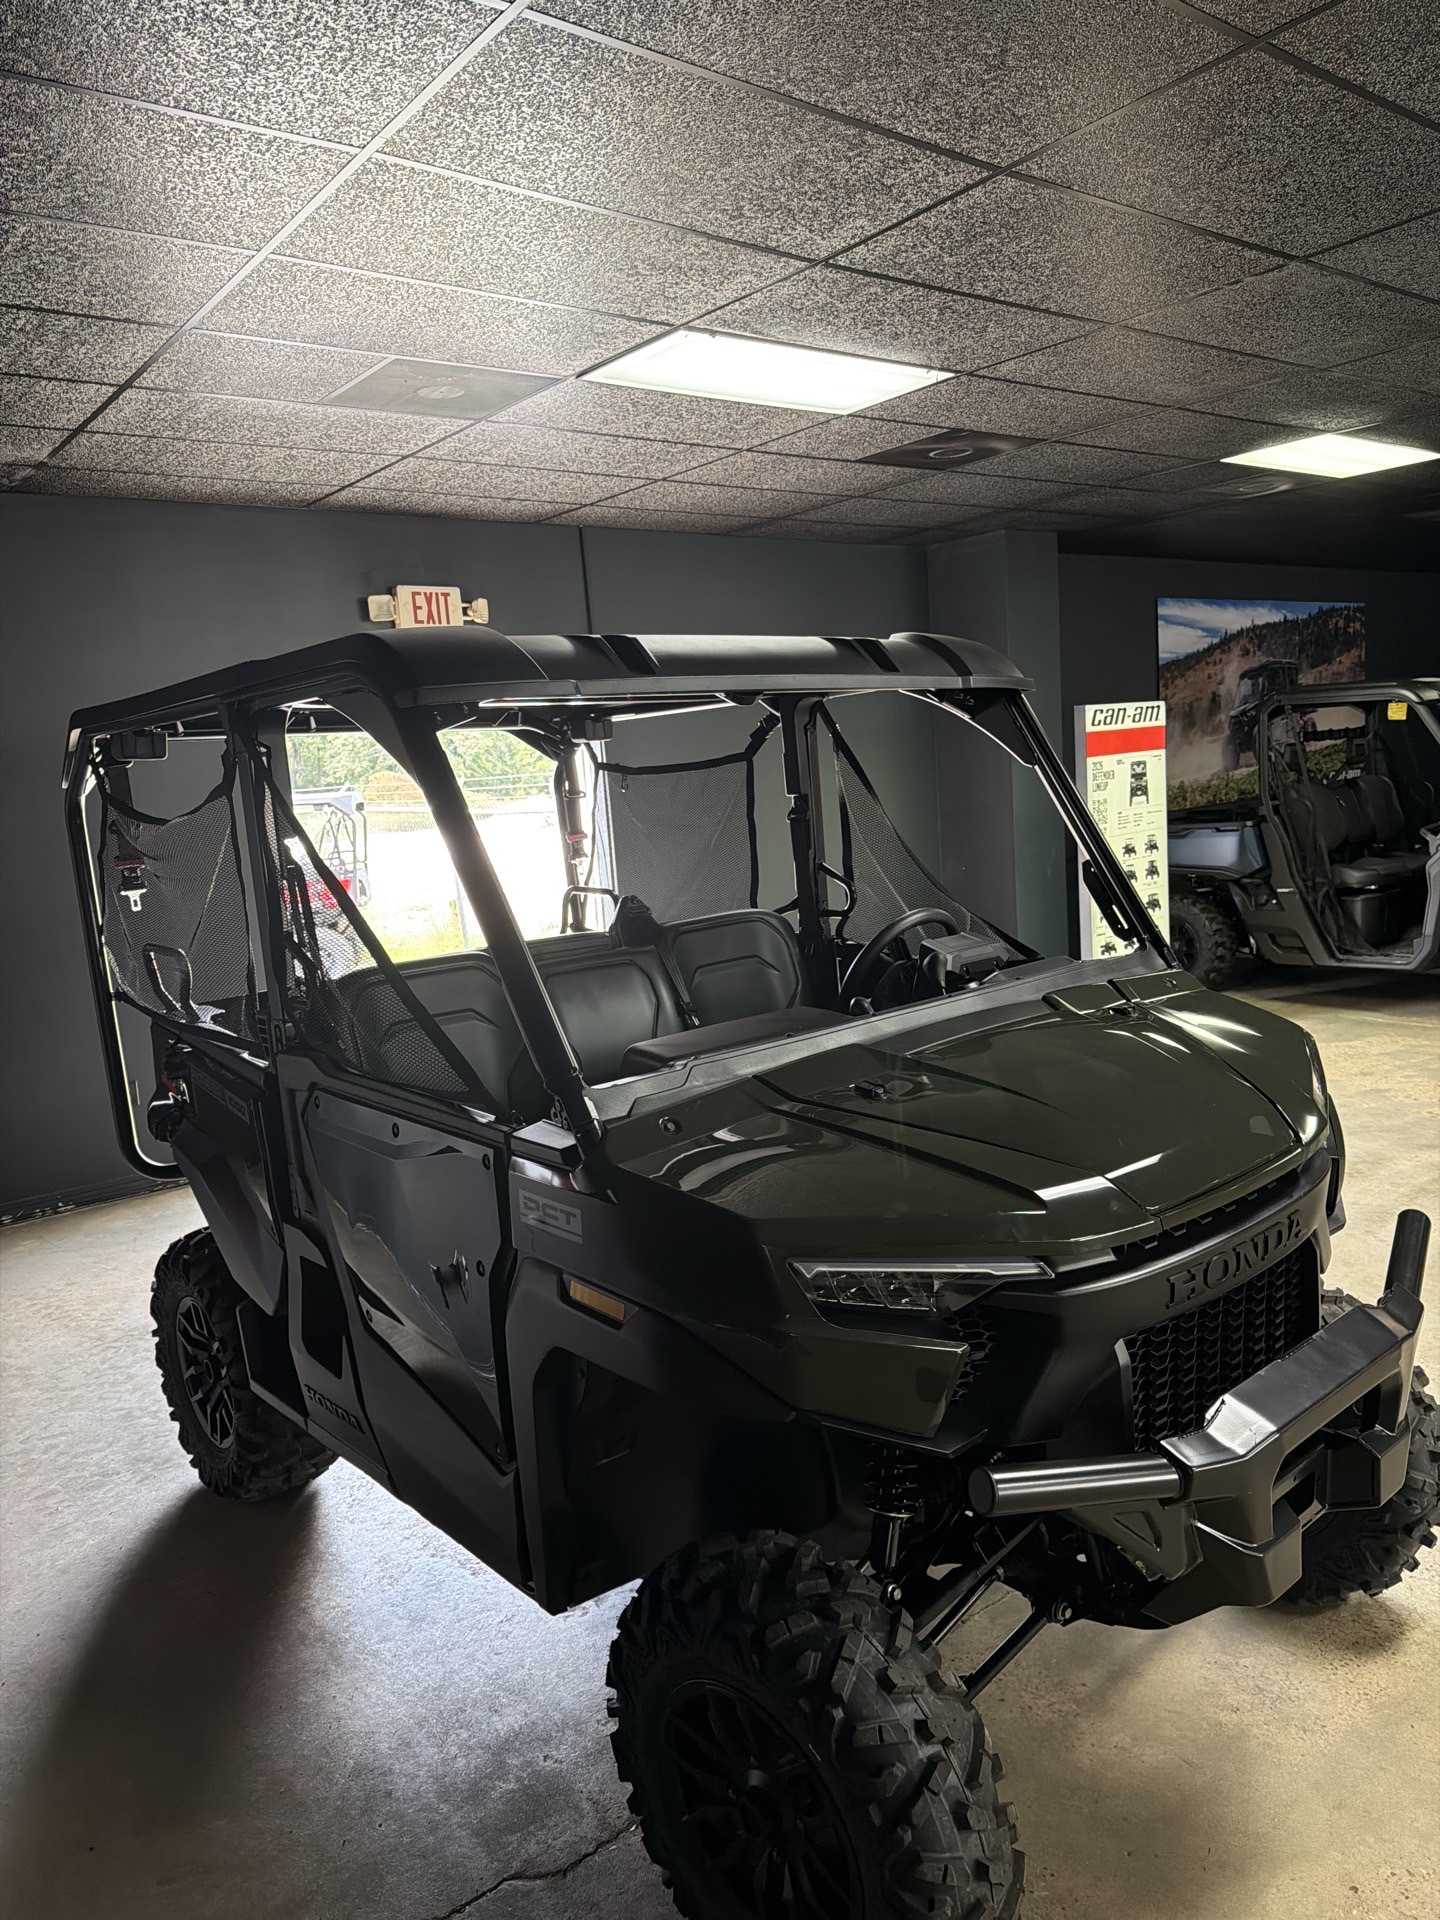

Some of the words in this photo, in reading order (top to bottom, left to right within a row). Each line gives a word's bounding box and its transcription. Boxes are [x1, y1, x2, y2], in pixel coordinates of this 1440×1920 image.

[411, 591, 451, 625] EXIT
[1091, 705, 1161, 726] can-am
[522, 1195, 577, 1226] DCT
[1166, 1209, 1303, 1309] HONDA
[303, 1383, 366, 1436] HONDA
